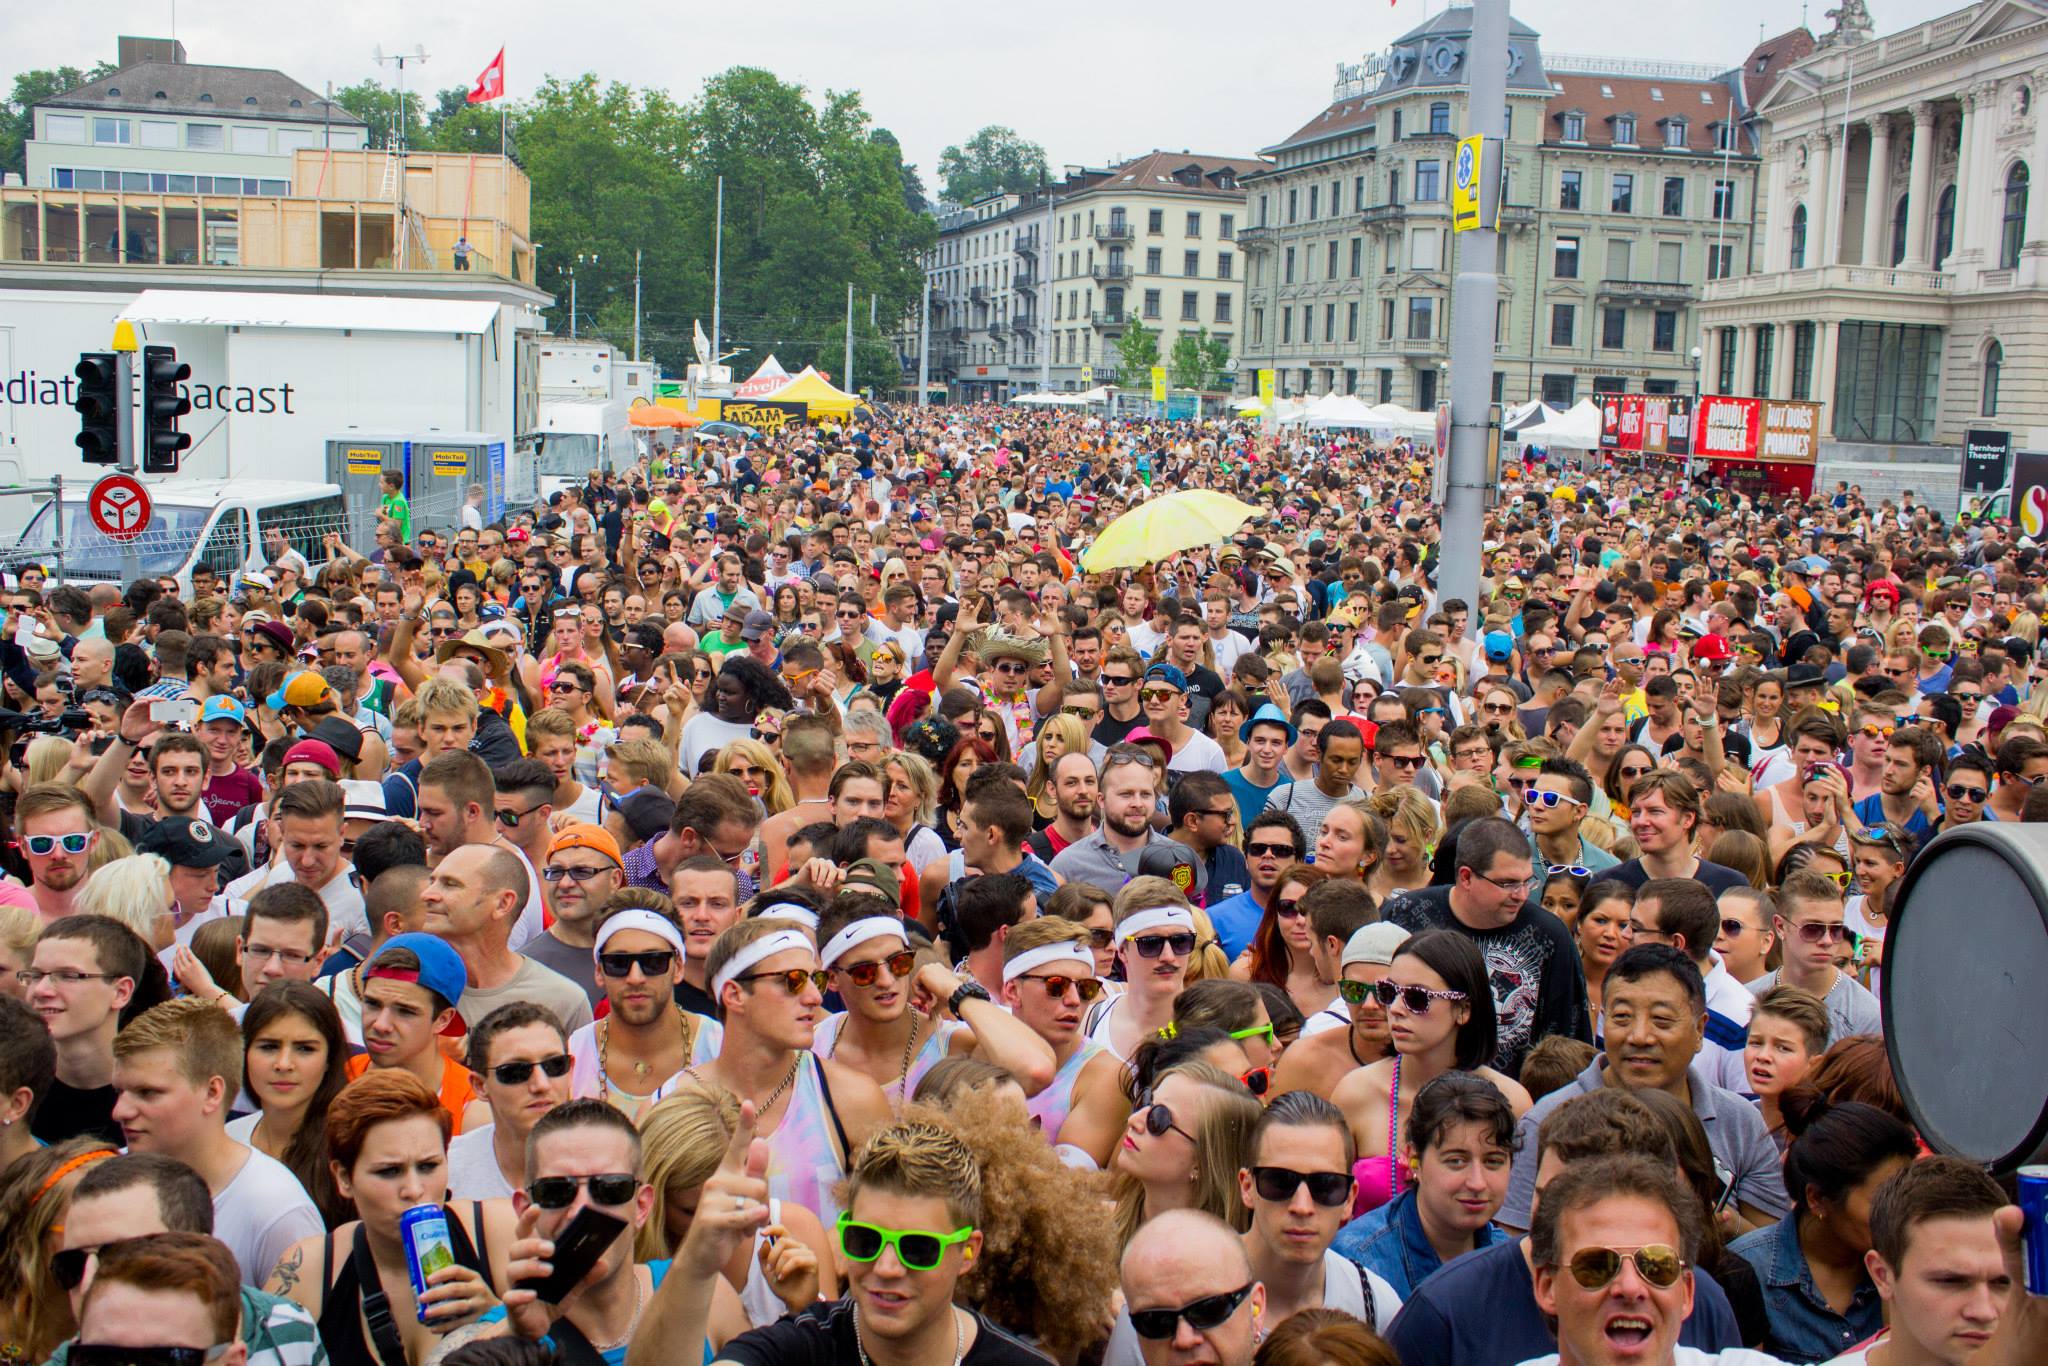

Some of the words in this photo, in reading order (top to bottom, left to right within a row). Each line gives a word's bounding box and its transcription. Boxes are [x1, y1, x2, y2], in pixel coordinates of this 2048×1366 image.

[731, 410, 780, 422] ADAM
[1707, 403, 1751, 428] DOUBLE
[1766, 405, 1787, 428] HOT
[1785, 407, 1813, 429] DOGS
[1705, 427, 1748, 452] BURGER
[1764, 432, 1811, 456] POMMES
[1969, 444, 2005, 453] Bernhard
[1969, 452, 1999, 460] Theater
